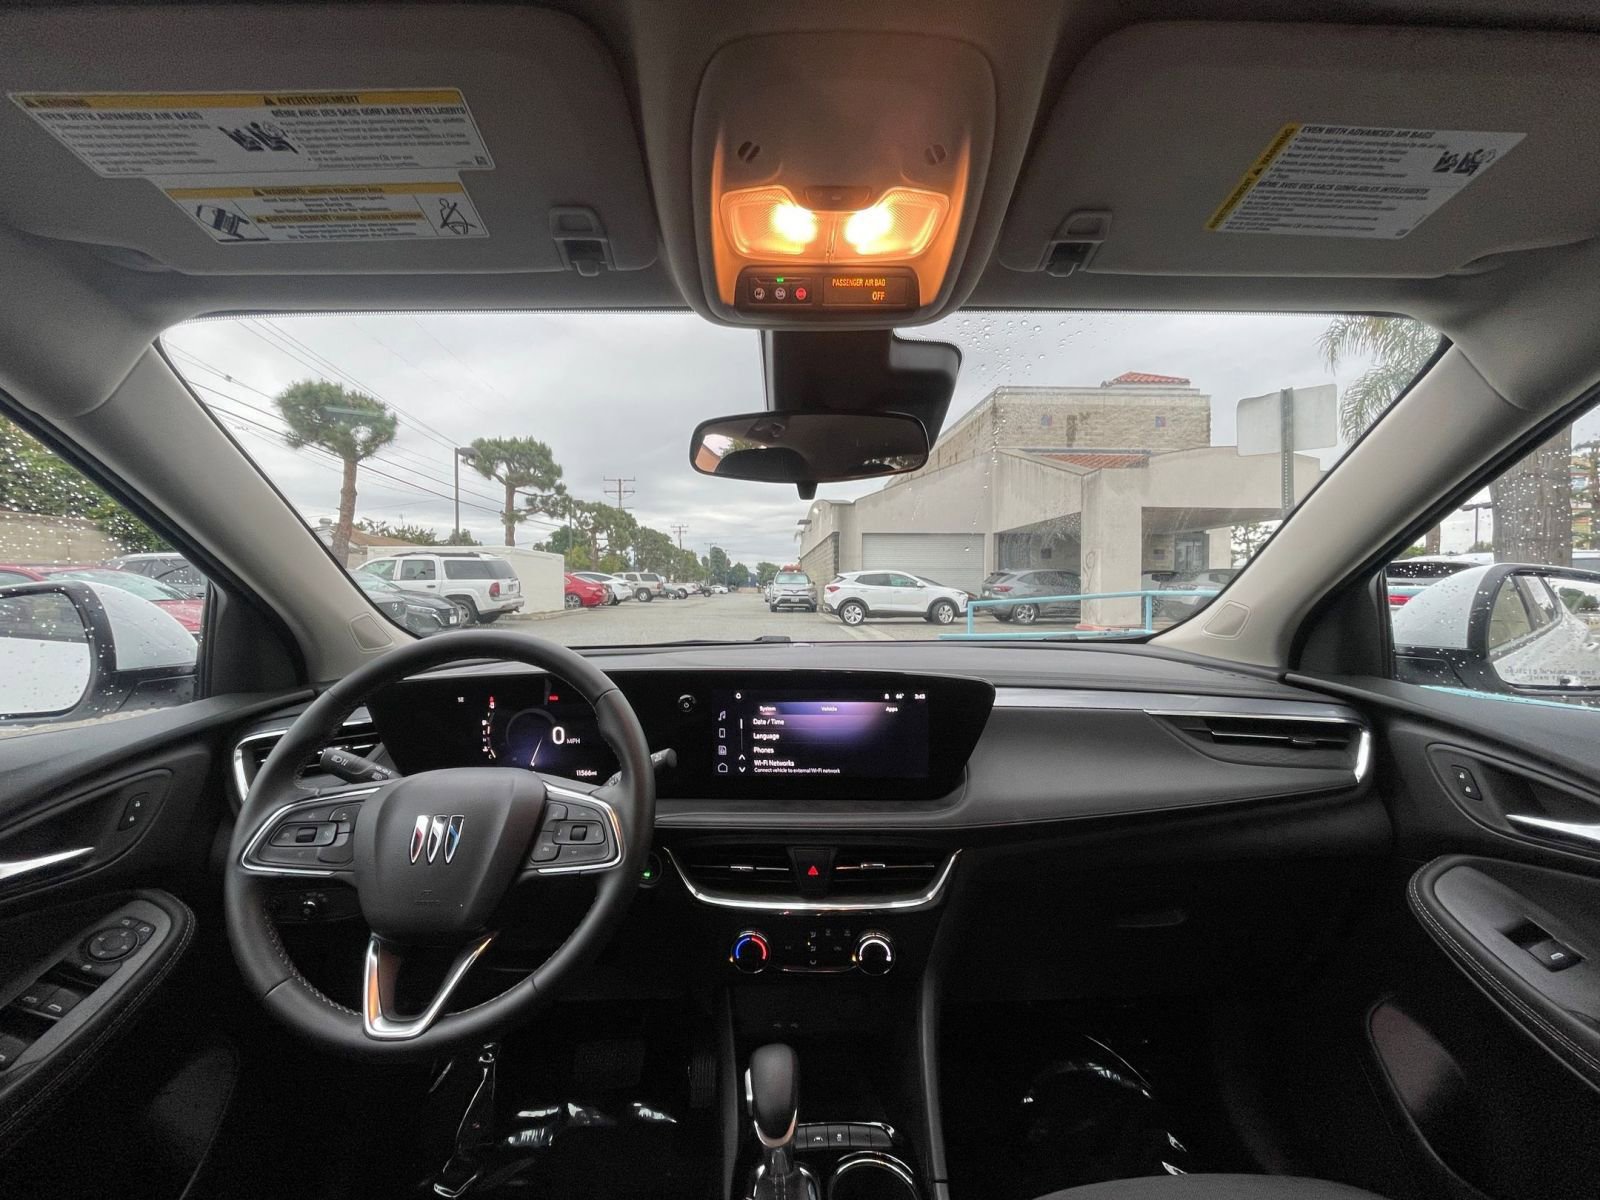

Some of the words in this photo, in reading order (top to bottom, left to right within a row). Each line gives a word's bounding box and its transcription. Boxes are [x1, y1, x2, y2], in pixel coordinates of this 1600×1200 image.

[276, 96, 360, 106] AVERTISSEMENT
[1301, 126, 1325, 134] EVEN
[1325, 127, 1348, 135] WITH
[1347, 129, 1394, 137] ADVANCED
[832, 278, 864, 287] PASSENGER
[864, 278, 874, 287] AIR
[875, 278, 886, 287] BAG
[872, 291, 885, 301] OFF
[552, 726, 566, 744] 0
[752, 732, 780, 740] Language
